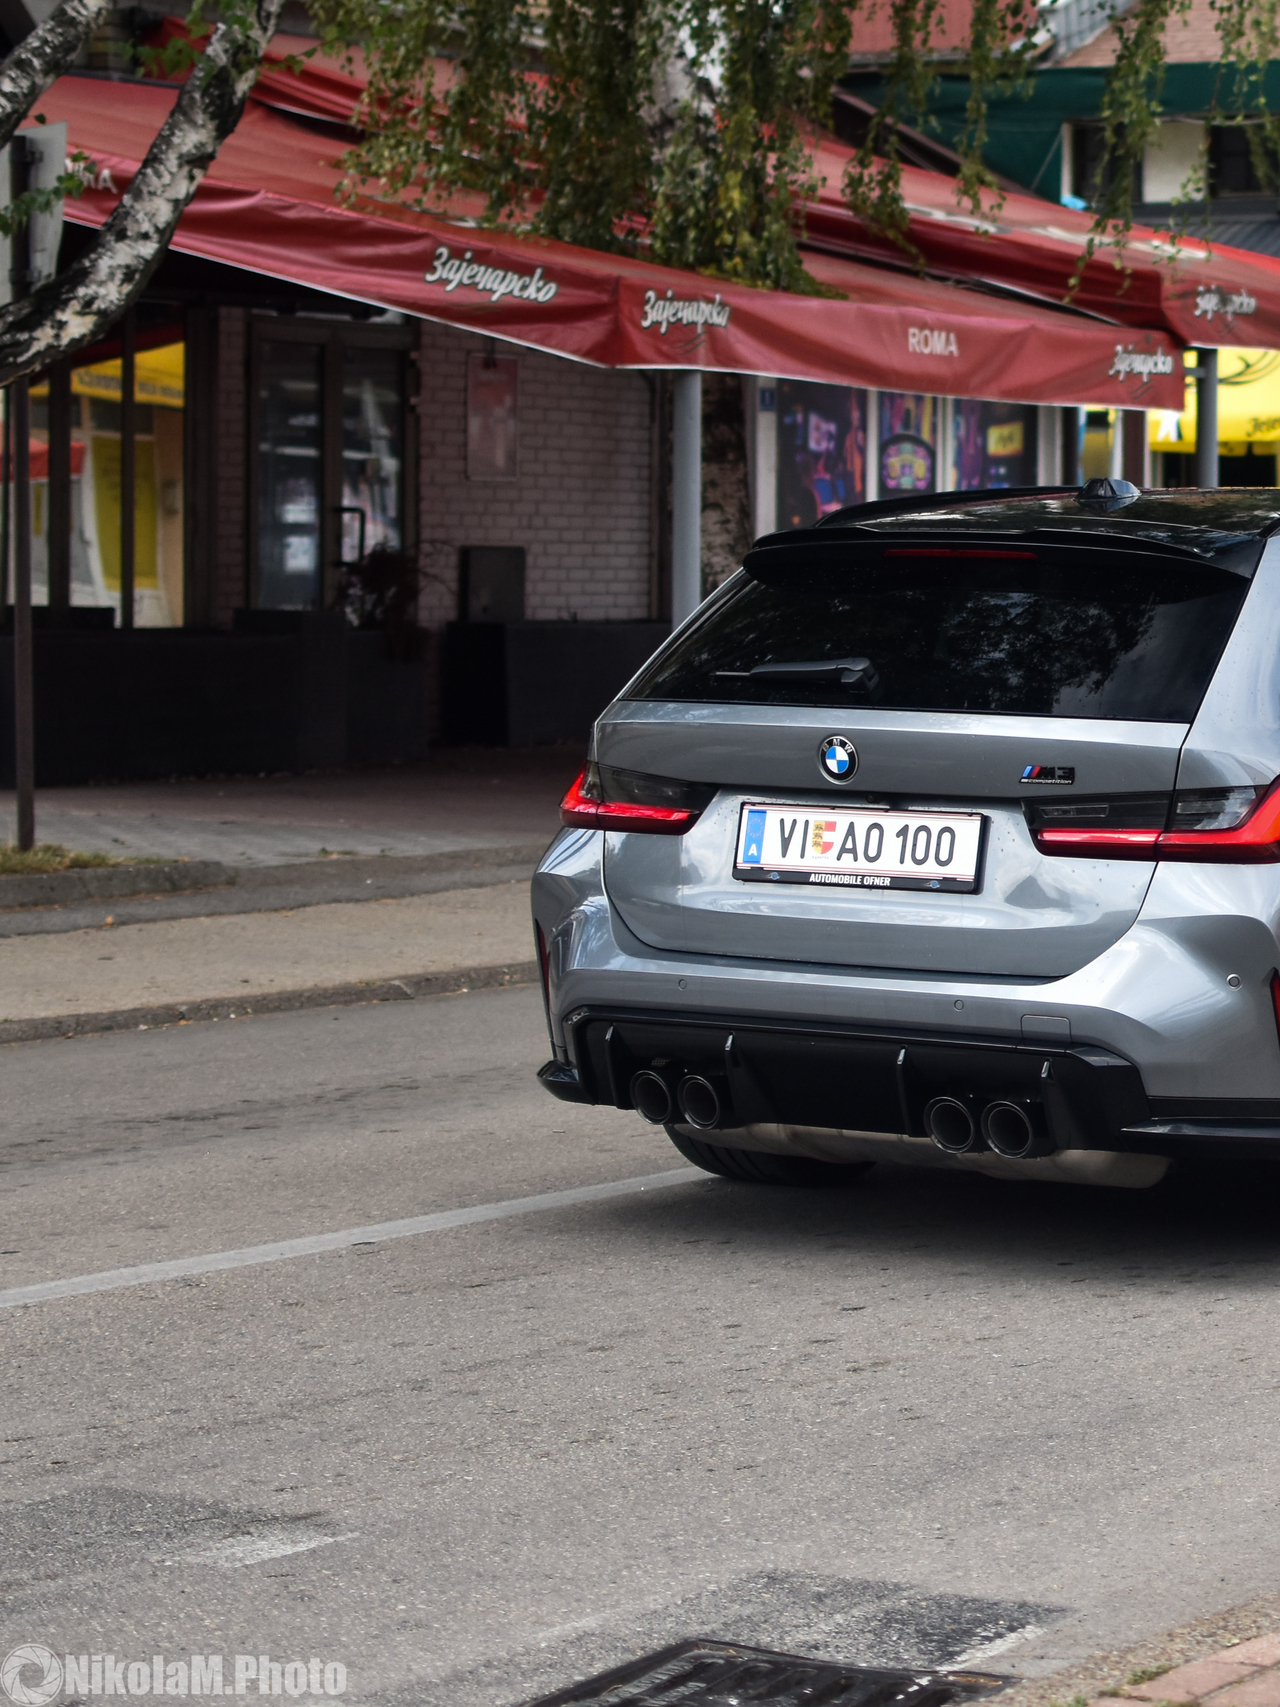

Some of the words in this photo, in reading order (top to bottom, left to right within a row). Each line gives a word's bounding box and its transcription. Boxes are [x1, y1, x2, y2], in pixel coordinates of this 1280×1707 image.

[907, 331, 960, 357] ROMA
[822, 738, 853, 754] BMW
[1036, 766, 1076, 779] M3
[748, 843, 757, 856] A
[779, 817, 810, 859] VI
[836, 821, 885, 863] AO
[896, 824, 956, 867] 100
[809, 873, 862, 885] AUTOMOBILE
[863, 876, 891, 887] OFNER
